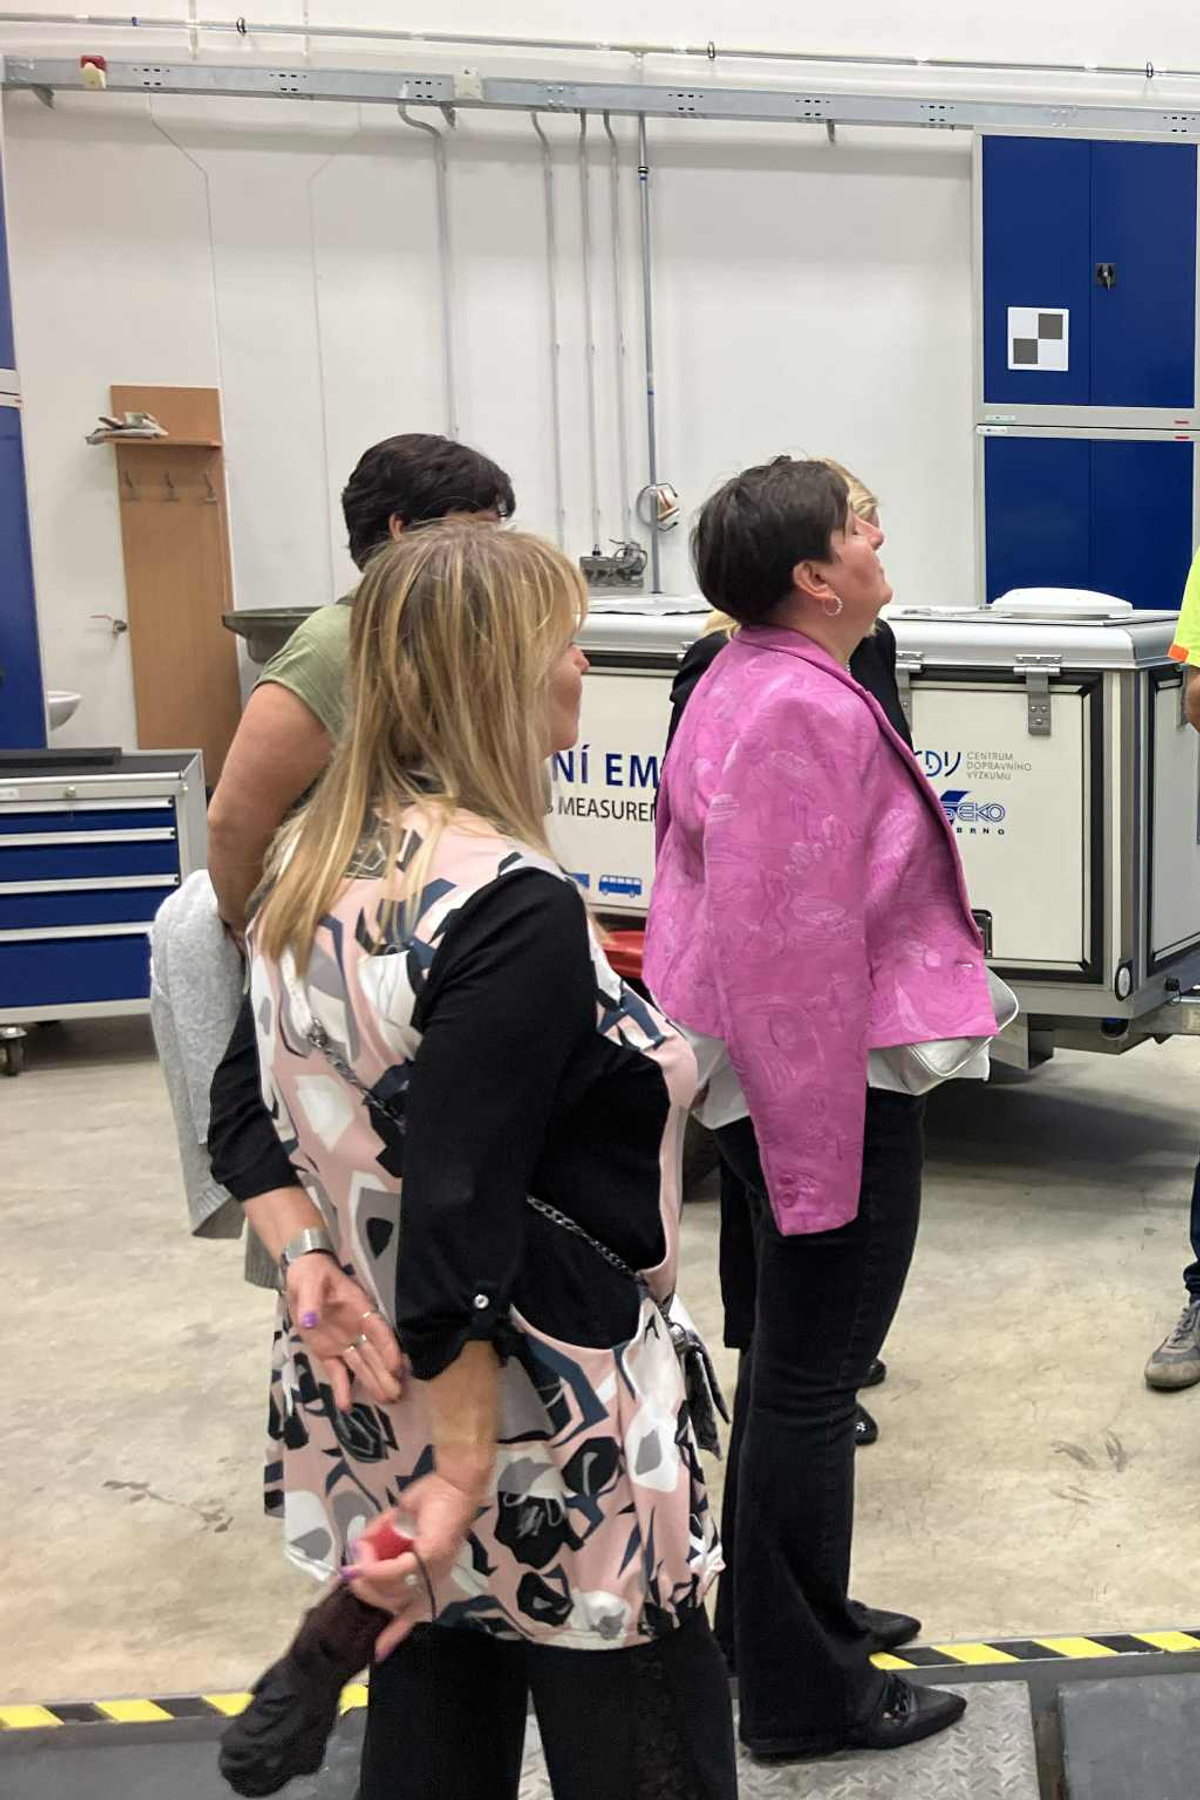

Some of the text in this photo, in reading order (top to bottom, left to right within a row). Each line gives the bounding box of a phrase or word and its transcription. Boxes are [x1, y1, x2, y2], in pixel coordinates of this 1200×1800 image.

[552, 744, 660, 789] NÍ EM
[914, 750, 961, 777] DV
[966, 751, 1014, 761] CENTRUM
